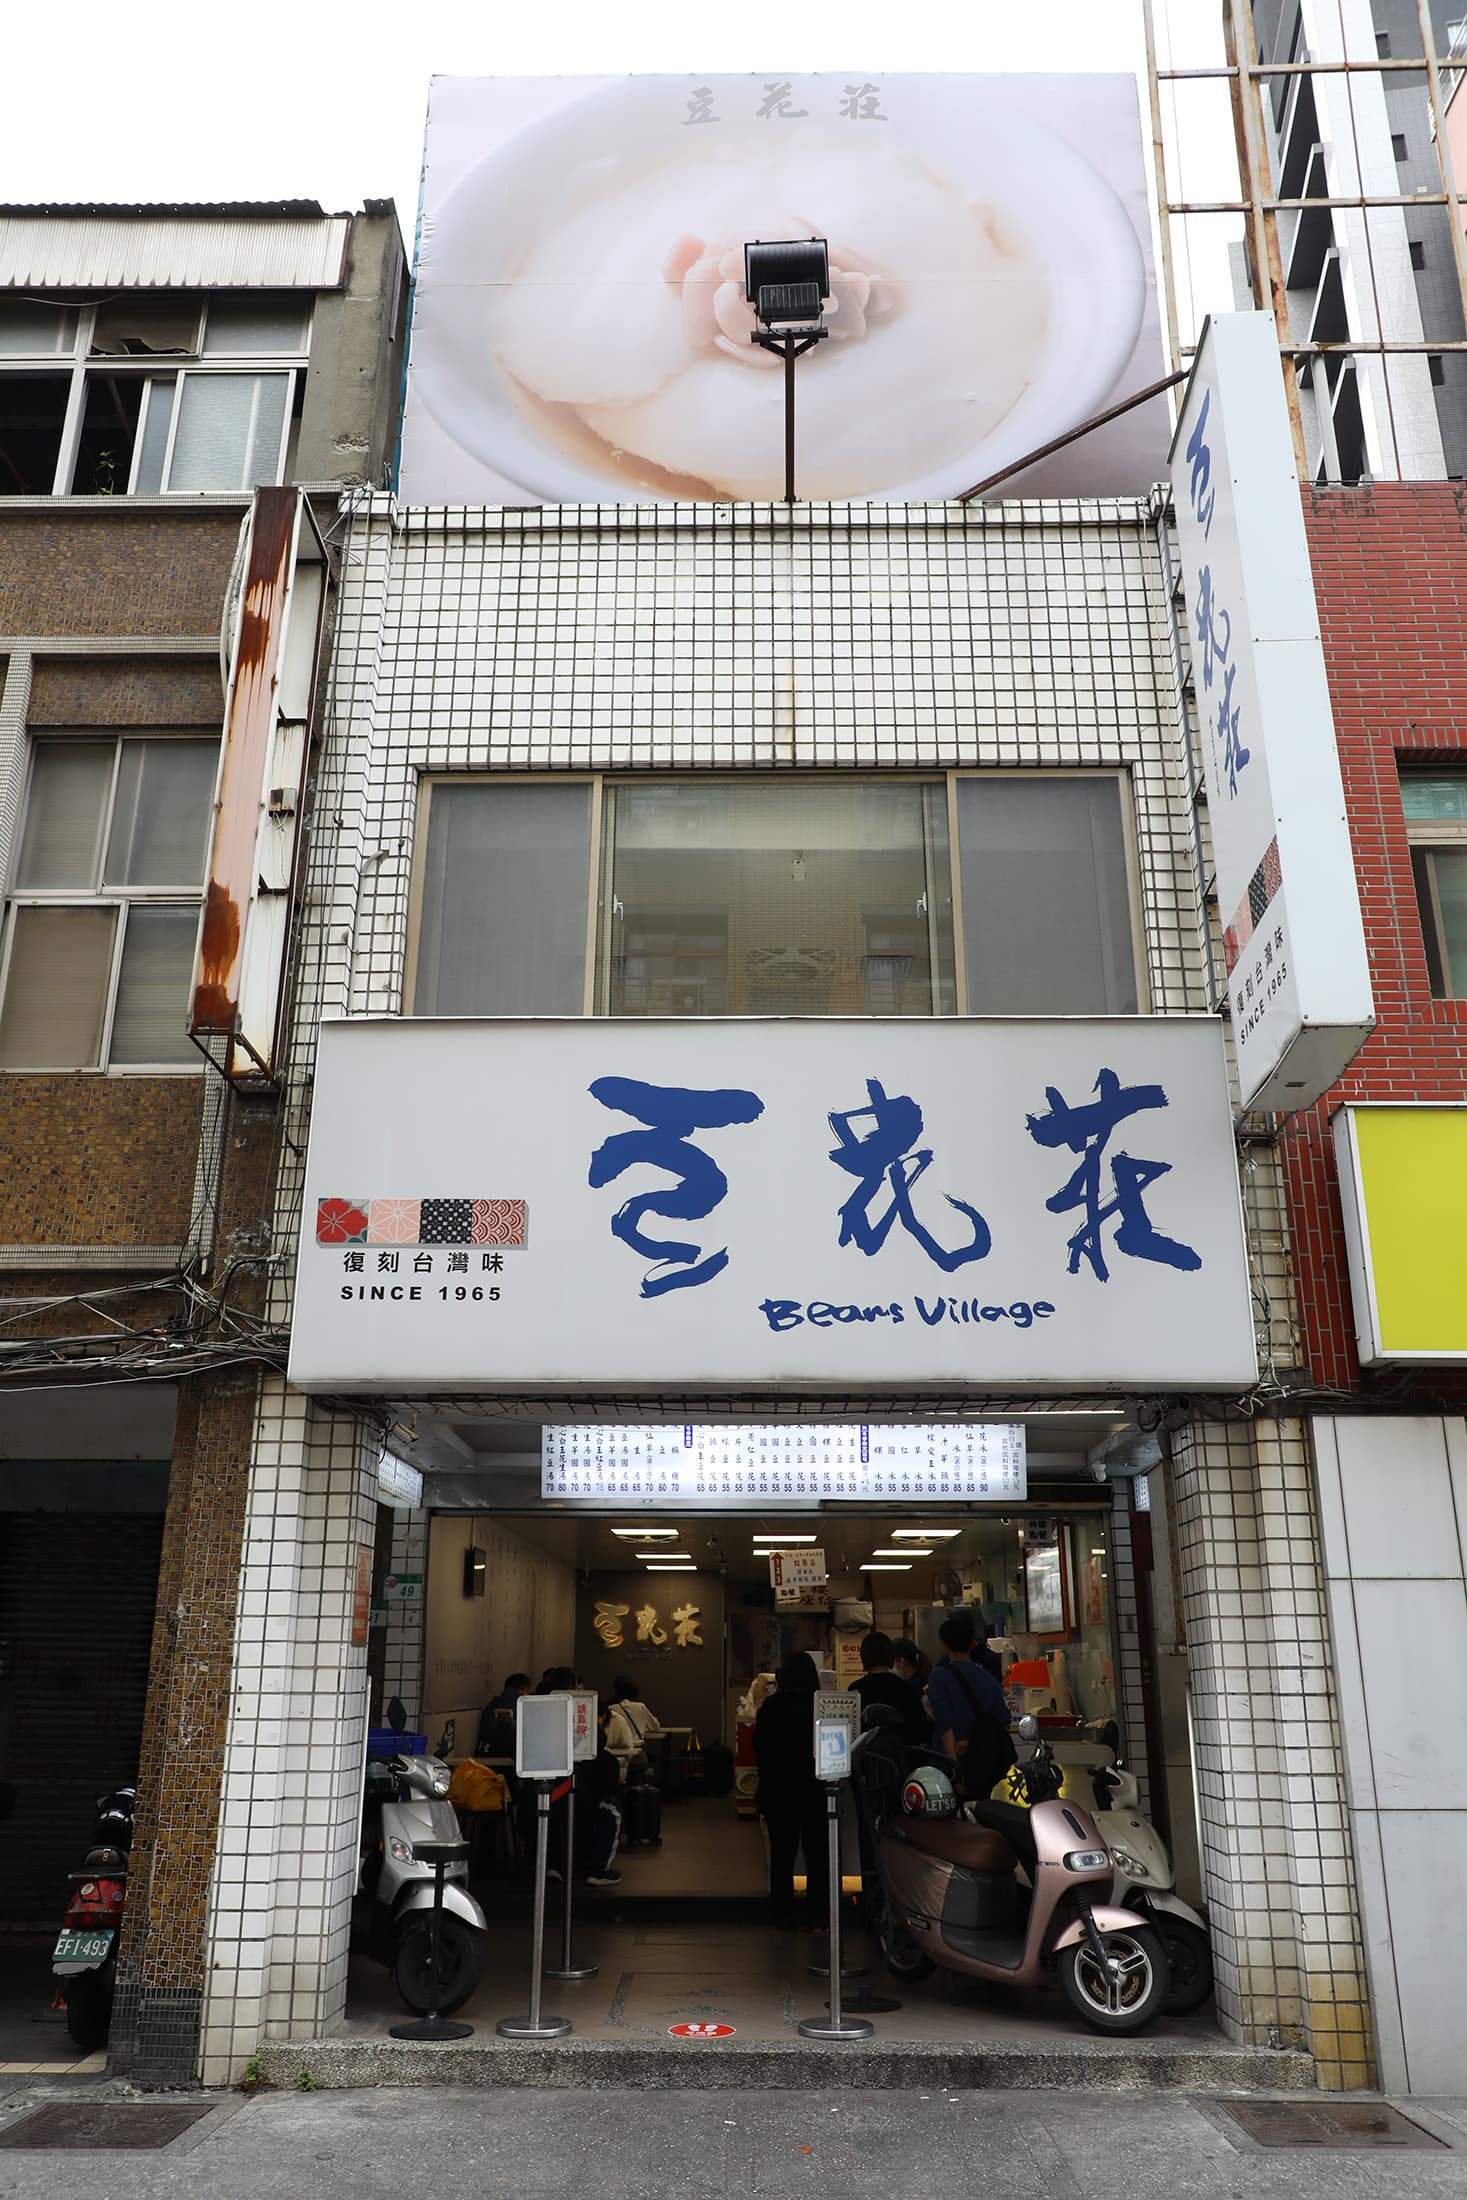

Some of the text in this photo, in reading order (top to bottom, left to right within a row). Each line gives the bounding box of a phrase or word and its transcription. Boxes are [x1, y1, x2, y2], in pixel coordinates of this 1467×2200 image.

[683, 82, 889, 126] 豆花莊
[1236, 924, 1284, 1016] 復刻台灣味
[1240, 962, 1287, 1046] SINCE 1965
[343, 1251, 504, 1274] 復刻台灣味
[340, 1285, 501, 1301] SINCE 1965
[759, 1296, 1054, 1332] Beans Village
[546, 1483, 554, 1492] 70
[558, 1483, 567, 1492] 80
[571, 1483, 579, 1492] 70
[583, 1483, 591, 1492] 70
[607, 1483, 616, 1492] 65
[620, 1483, 629, 1492] 65
[632, 1483, 641, 1492] 65
[645, 1483, 654, 1492] 70
[658, 1483, 667, 1492] 60
[671, 1483, 680, 1492] 70
[696, 1483, 705, 1492] 65
[708, 1483, 718, 1492] 65
[722, 1483, 731, 1492] 55
[734, 1483, 743, 1492] 55
[747, 1483, 756, 1492] 55
[760, 1483, 768, 1492] 55
[772, 1483, 780, 1492] 55
[784, 1483, 793, 1492] 55
[797, 1483, 805, 1492] 55
[809, 1483, 818, 1492] 55
[823, 1483, 831, 1492] 55
[836, 1483, 845, 1492] 55
[848, 1483, 857, 1492] 55
[874, 1483, 883, 1492] 55
[887, 1483, 897, 1492] 55
[901, 1483, 910, 1492] 55
[915, 1483, 923, 1492] 55
[928, 1483, 936, 1492] 65
[940, 1483, 949, 1492] 85
[953, 1483, 962, 1492] 85
[966, 1483, 975, 1492] 85
[980, 1483, 989, 1492] 90
[399, 1586, 415, 1597] 49
